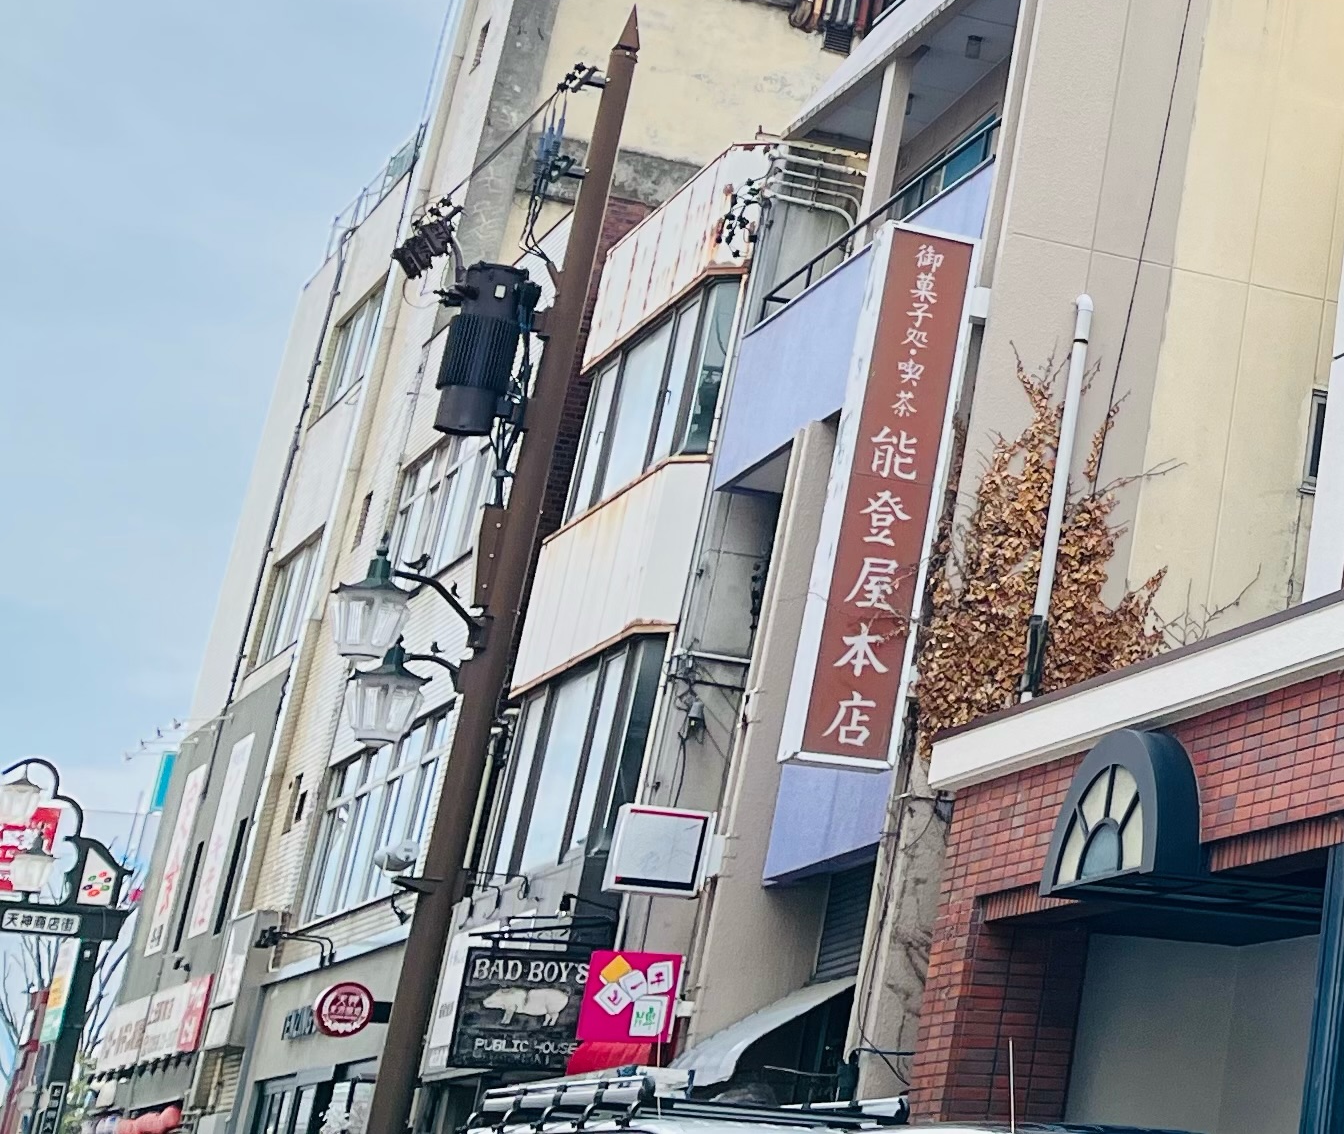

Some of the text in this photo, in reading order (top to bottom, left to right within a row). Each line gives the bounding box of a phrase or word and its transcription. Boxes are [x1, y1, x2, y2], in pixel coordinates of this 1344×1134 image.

[821, 425, 919, 748] 能登屋本店
[4, 912, 75, 933] 天神商店街
[472, 958, 590, 984] BAD BOY'S
[474, 1037, 529, 1053] PUBLIC
